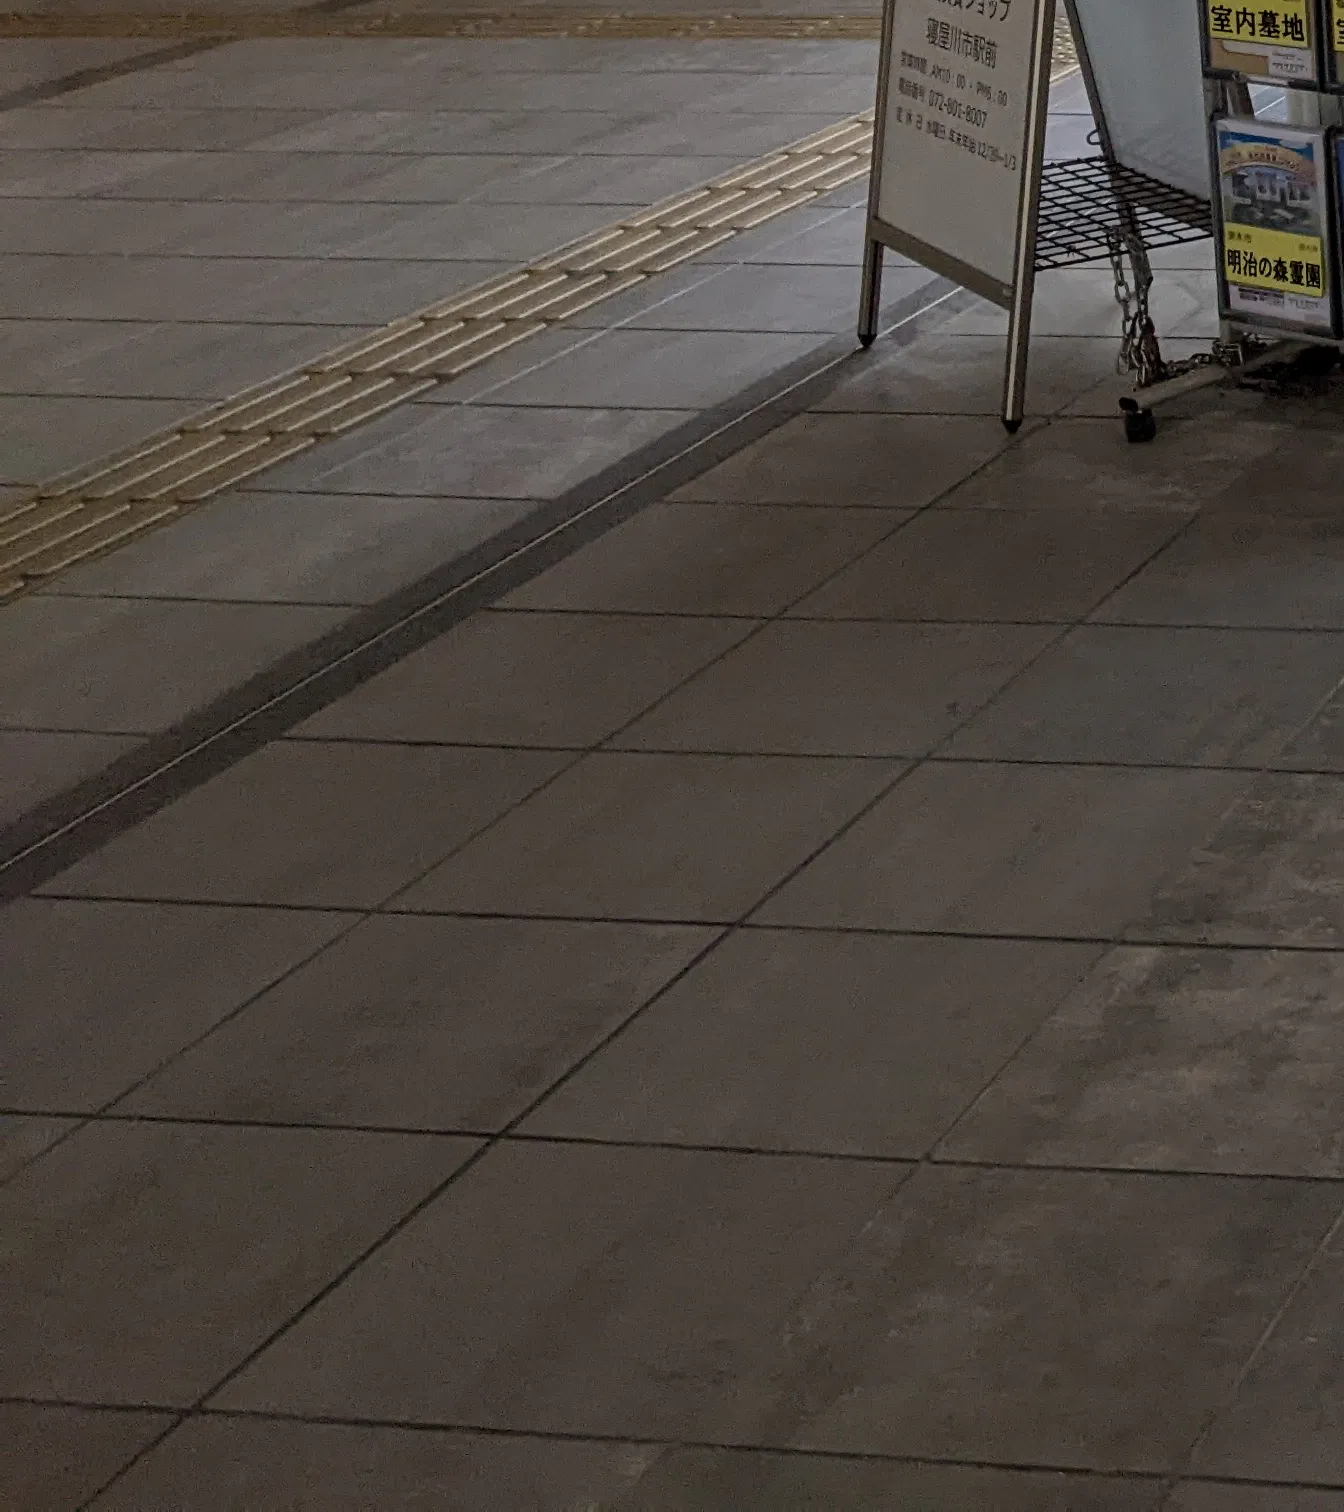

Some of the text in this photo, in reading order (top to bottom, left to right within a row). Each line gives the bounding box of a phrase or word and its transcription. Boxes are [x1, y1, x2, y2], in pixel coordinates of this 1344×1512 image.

[926, 16, 998, 70] 寝屋川市駅前
[1210, 4, 1305, 43] 室内墓地
[1227, 249, 1321, 289] 明治の森霊園
